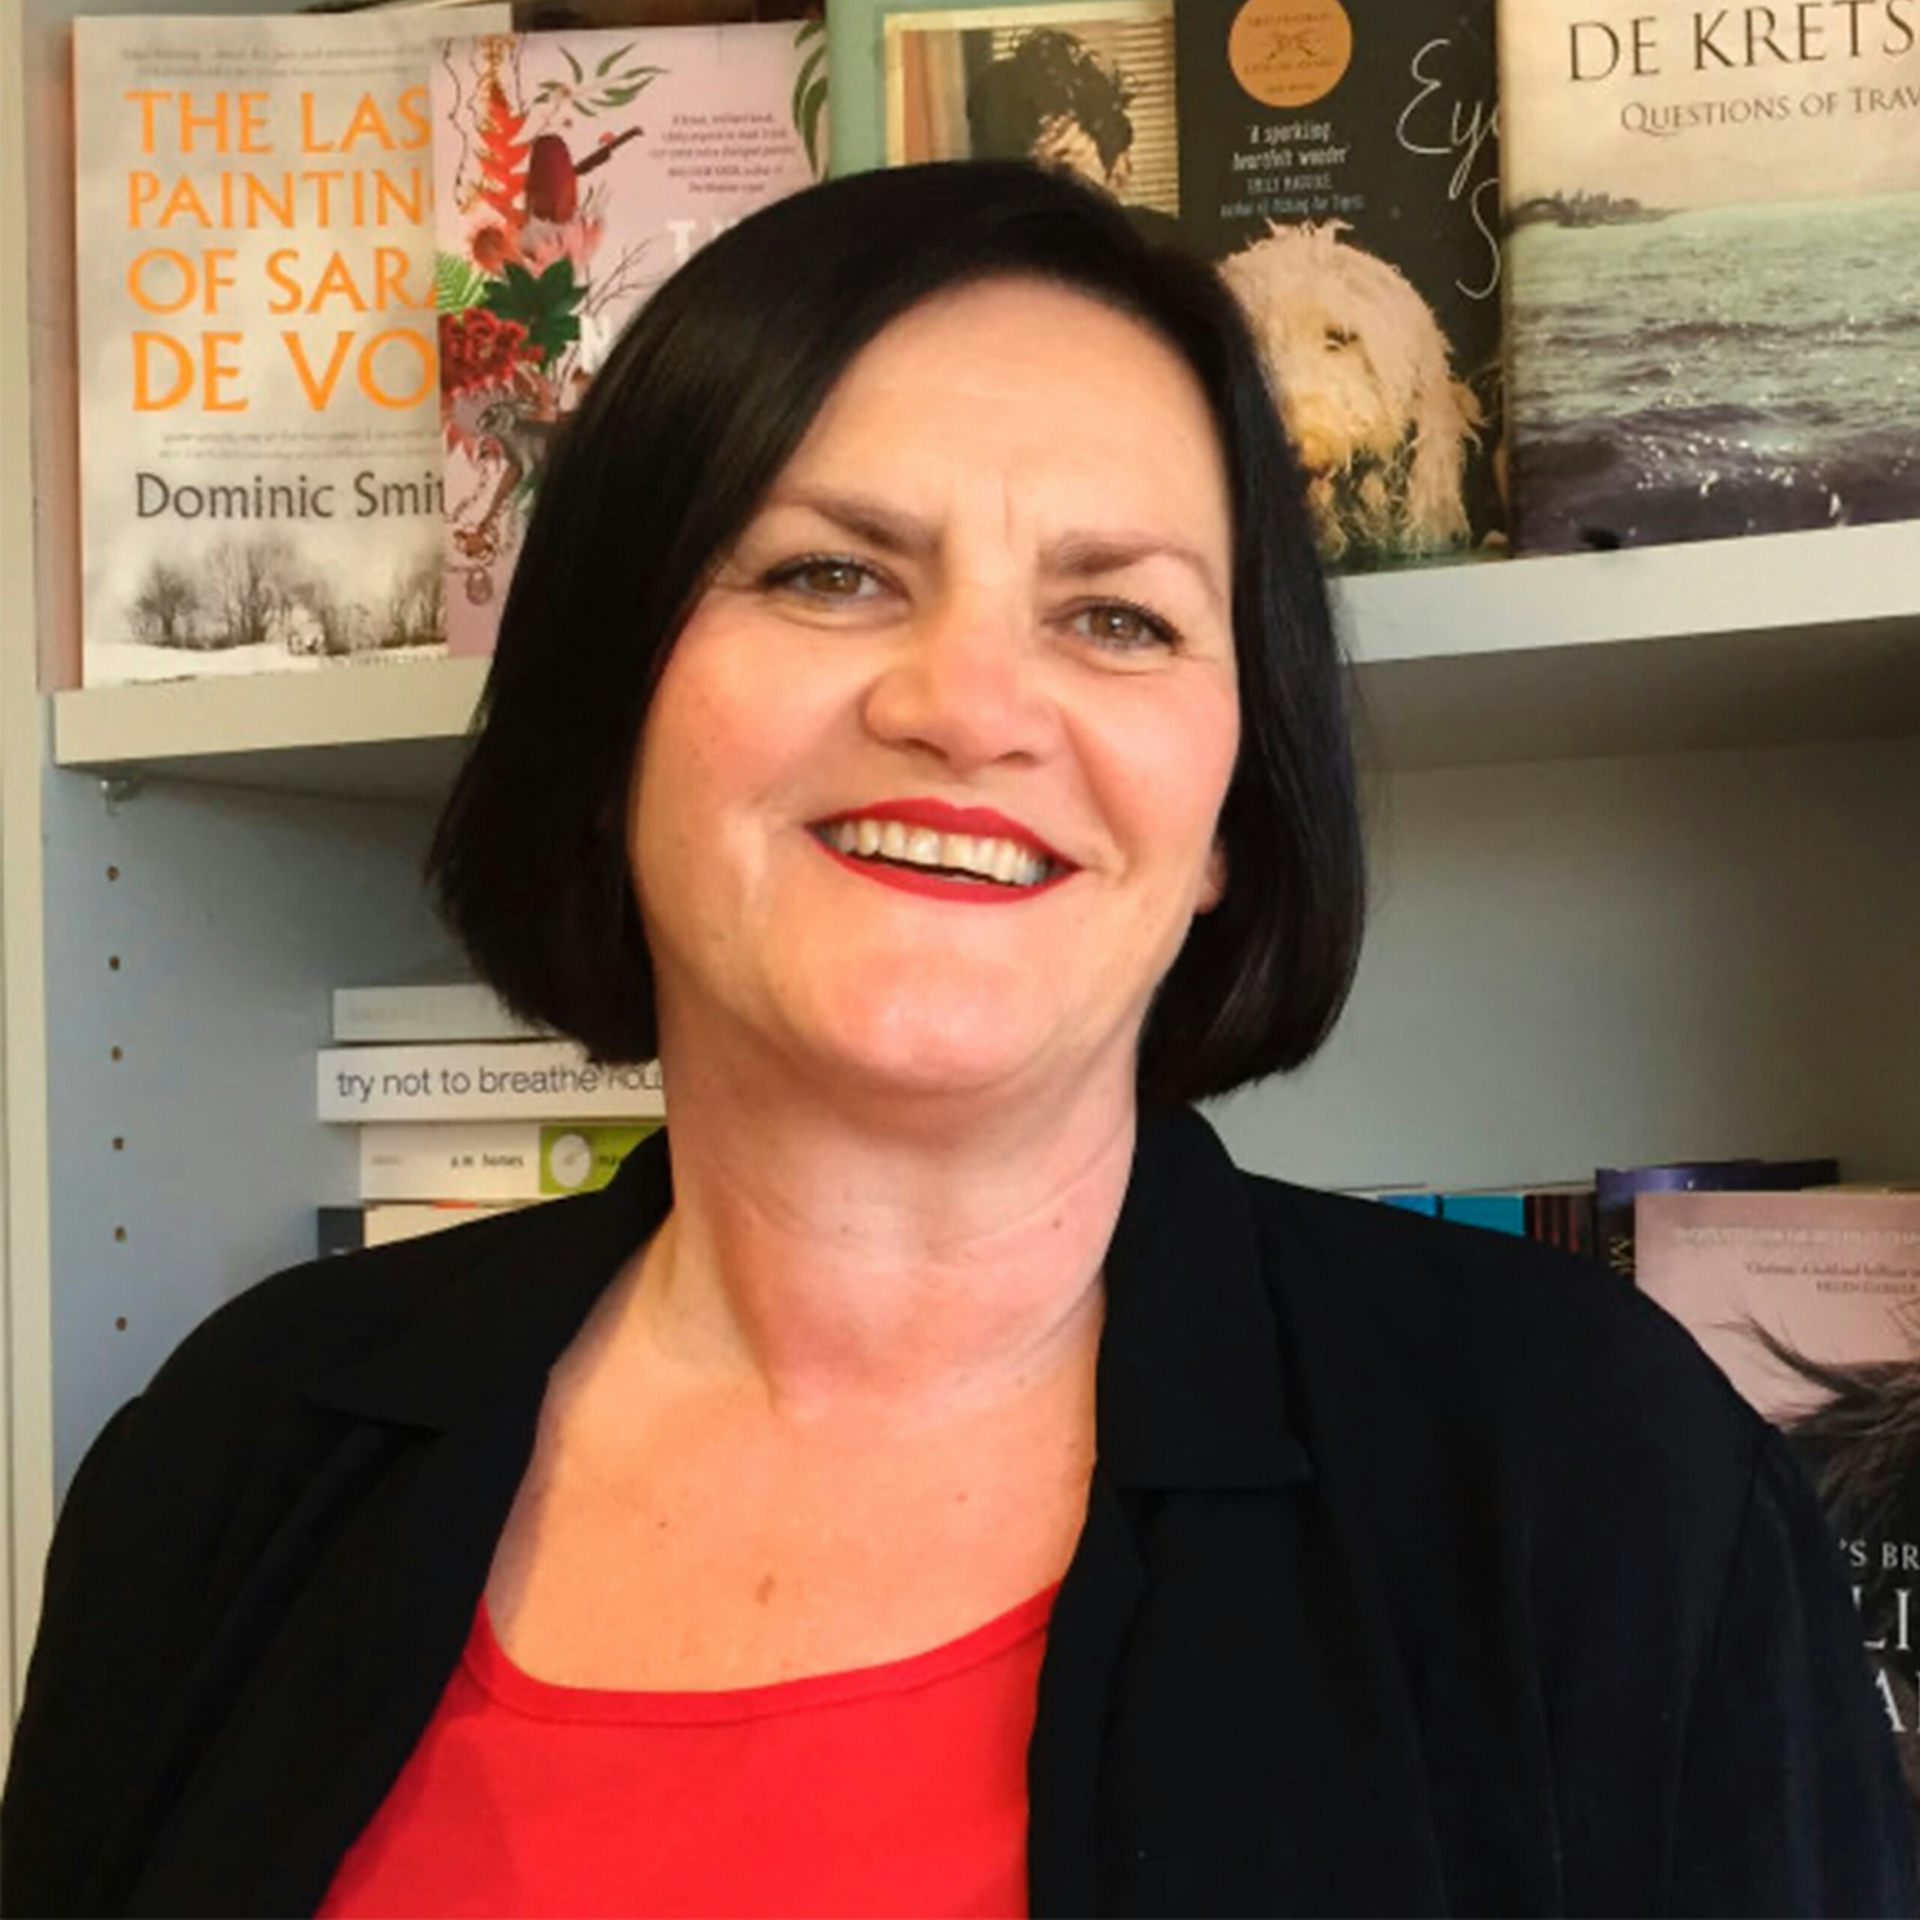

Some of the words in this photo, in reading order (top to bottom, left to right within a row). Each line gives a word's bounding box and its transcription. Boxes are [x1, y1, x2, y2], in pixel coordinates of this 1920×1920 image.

[1568, 16, 1661, 82] DE
[1694, 0, 1914, 72] KRETS
[123, 91, 274, 155] THE
[301, 86, 432, 153] LAS
[1396, 38, 1499, 200] Ey
[1800, 91, 1838, 118] OF
[1847, 85, 1920, 114] TRAV
[128, 169, 435, 230] PAINTIN
[1457, 177, 1500, 299] S
[127, 247, 238, 315] OF
[132, 330, 249, 412] DE
[282, 326, 438, 412] VO
[135, 471, 334, 519] Dominic
[353, 470, 445, 518] Smit
[336, 1072, 375, 1102] try
[382, 1069, 431, 1097] not
[440, 1069, 472, 1095] to
[479, 1066, 599, 1094] breathe
[1839, 1537, 1867, 1567] 'S
[1880, 1541, 1920, 1570] BR
